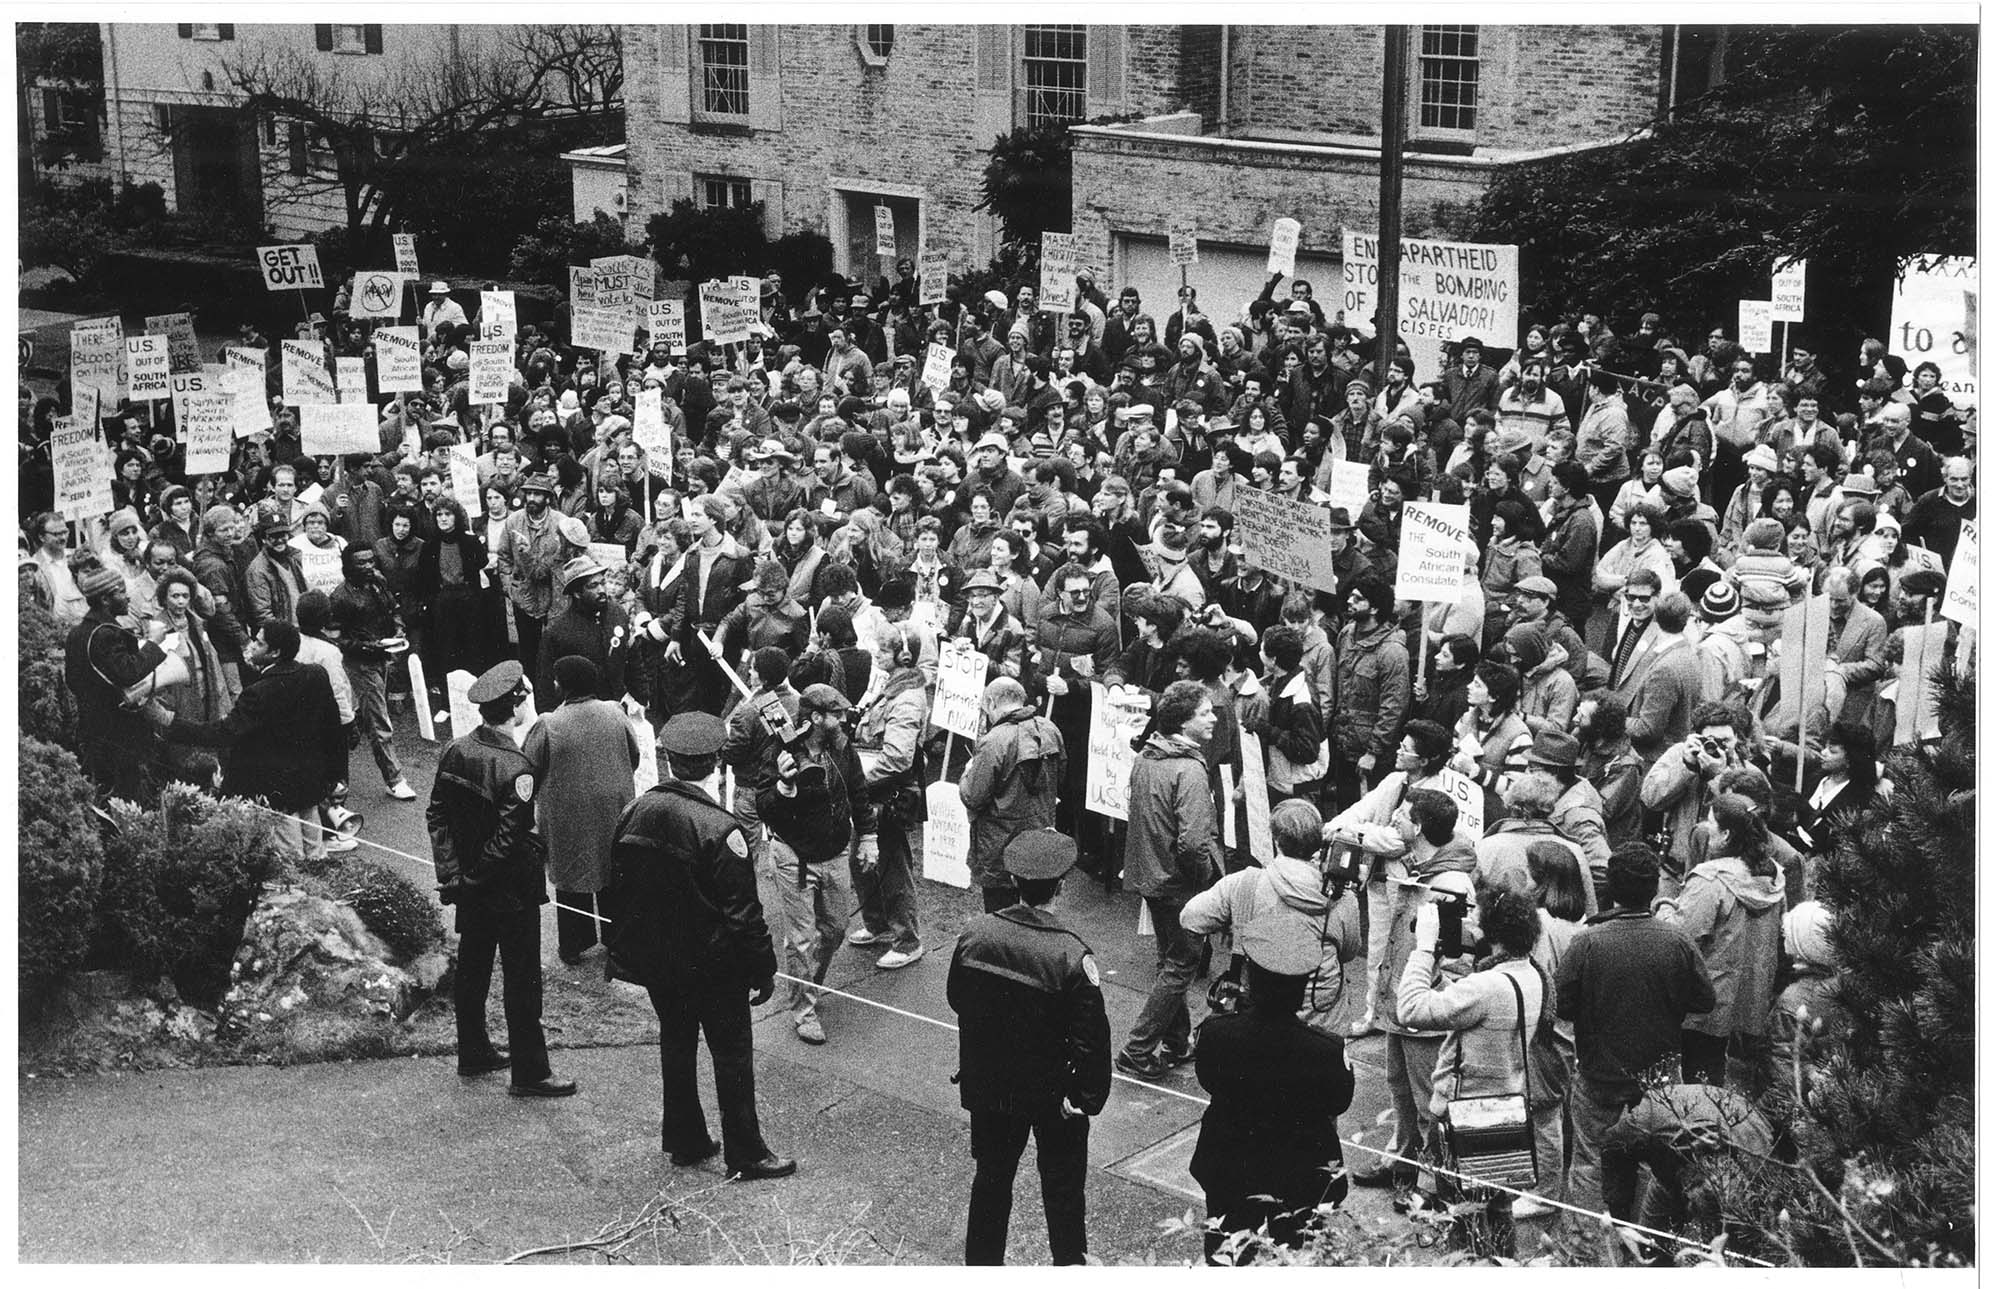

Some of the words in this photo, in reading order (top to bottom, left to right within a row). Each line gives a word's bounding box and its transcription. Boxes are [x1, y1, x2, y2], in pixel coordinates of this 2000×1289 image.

[264, 247, 300, 266] GET
[1354, 237, 1378, 259] EN
[1400, 242, 1498, 272] APARTHEID
[594, 276, 631, 291] MUST
[1344, 262, 1379, 285] STO
[1436, 273, 1509, 303] BOMBING
[703, 294, 740, 307] REMOVE
[1776, 294, 1802, 303] SOUTH
[1345, 290, 1367, 311] OF
[1408, 297, 1496, 331] SALVADOR!
[1774, 303, 1801, 312] AFRICA
[655, 319, 671, 328] OUT
[671, 318, 683, 327] OF
[1400, 320, 1453, 339] CISPES
[376, 330, 419, 351] REMOVE
[654, 332, 684, 341] SOUTH
[1898, 320, 1934, 353] to
[283, 341, 323, 366] REMOVE
[472, 343, 510, 355] FREEDOM
[135, 358, 152, 368] OUT
[153, 356, 166, 367] OF
[133, 371, 168, 382] SOUTH
[381, 374, 420, 382] Consulate
[131, 380, 167, 391] AFRICA
[173, 377, 208, 393] U.S.
[1616, 380, 1665, 408] AACP
[52, 427, 96, 447] FREEDOM
[1404, 505, 1467, 543] REMOVE
[1409, 531, 1426, 543] THE
[1425, 547, 1461, 559] South
[1289, 554, 1311, 570] YOU
[1419, 561, 1461, 573] African
[1401, 572, 1459, 586] Consulate
[944, 648, 985, 680] STOP
[1105, 762, 1117, 785] by
[1443, 773, 1472, 804] U.S.
[1467, 815, 1481, 829] OF
